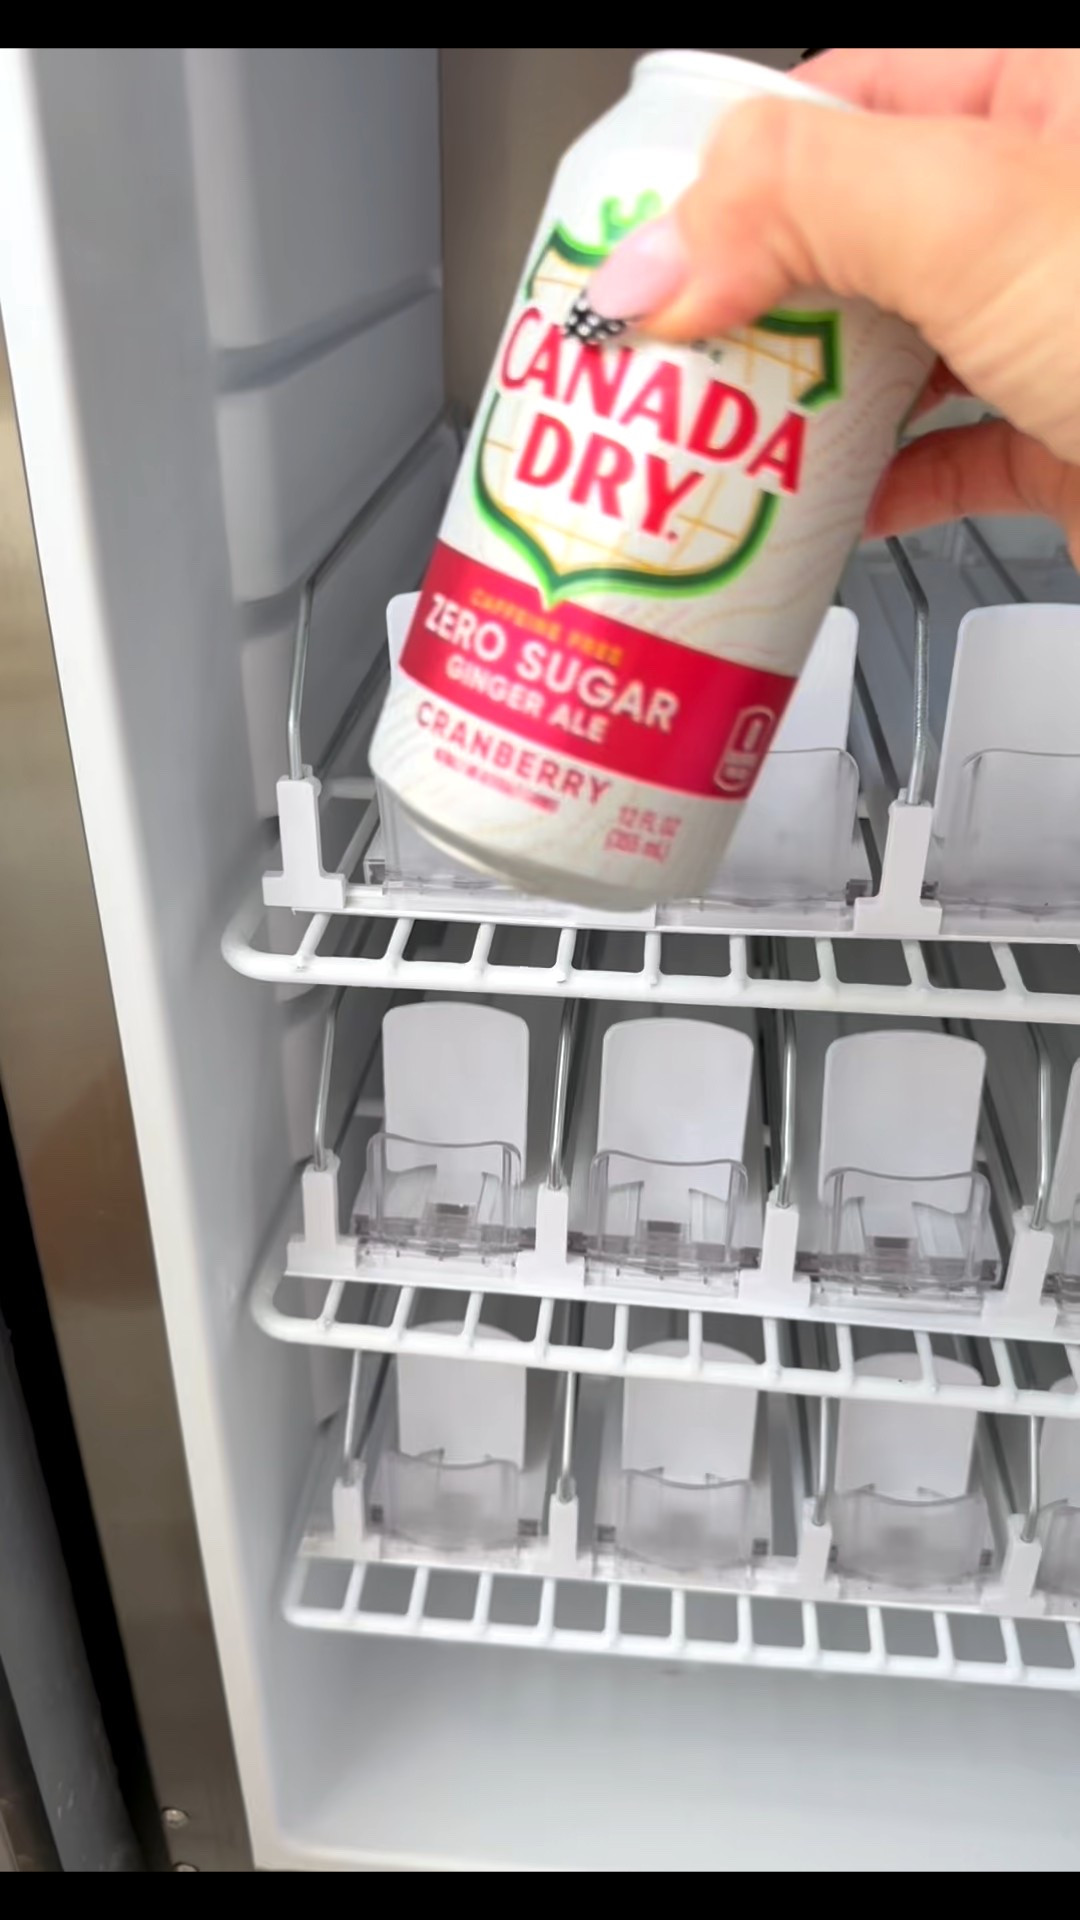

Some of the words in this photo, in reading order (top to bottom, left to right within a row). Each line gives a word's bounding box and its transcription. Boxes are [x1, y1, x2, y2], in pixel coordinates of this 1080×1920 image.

[499, 306, 806, 495] CANADA
[424, 593, 507, 661] ZERO
[516, 641, 680, 734] SUGAR
[445, 654, 546, 718] GINGER
[549, 703, 611, 744] ALE
[415, 700, 612, 805] CRANBERRY
